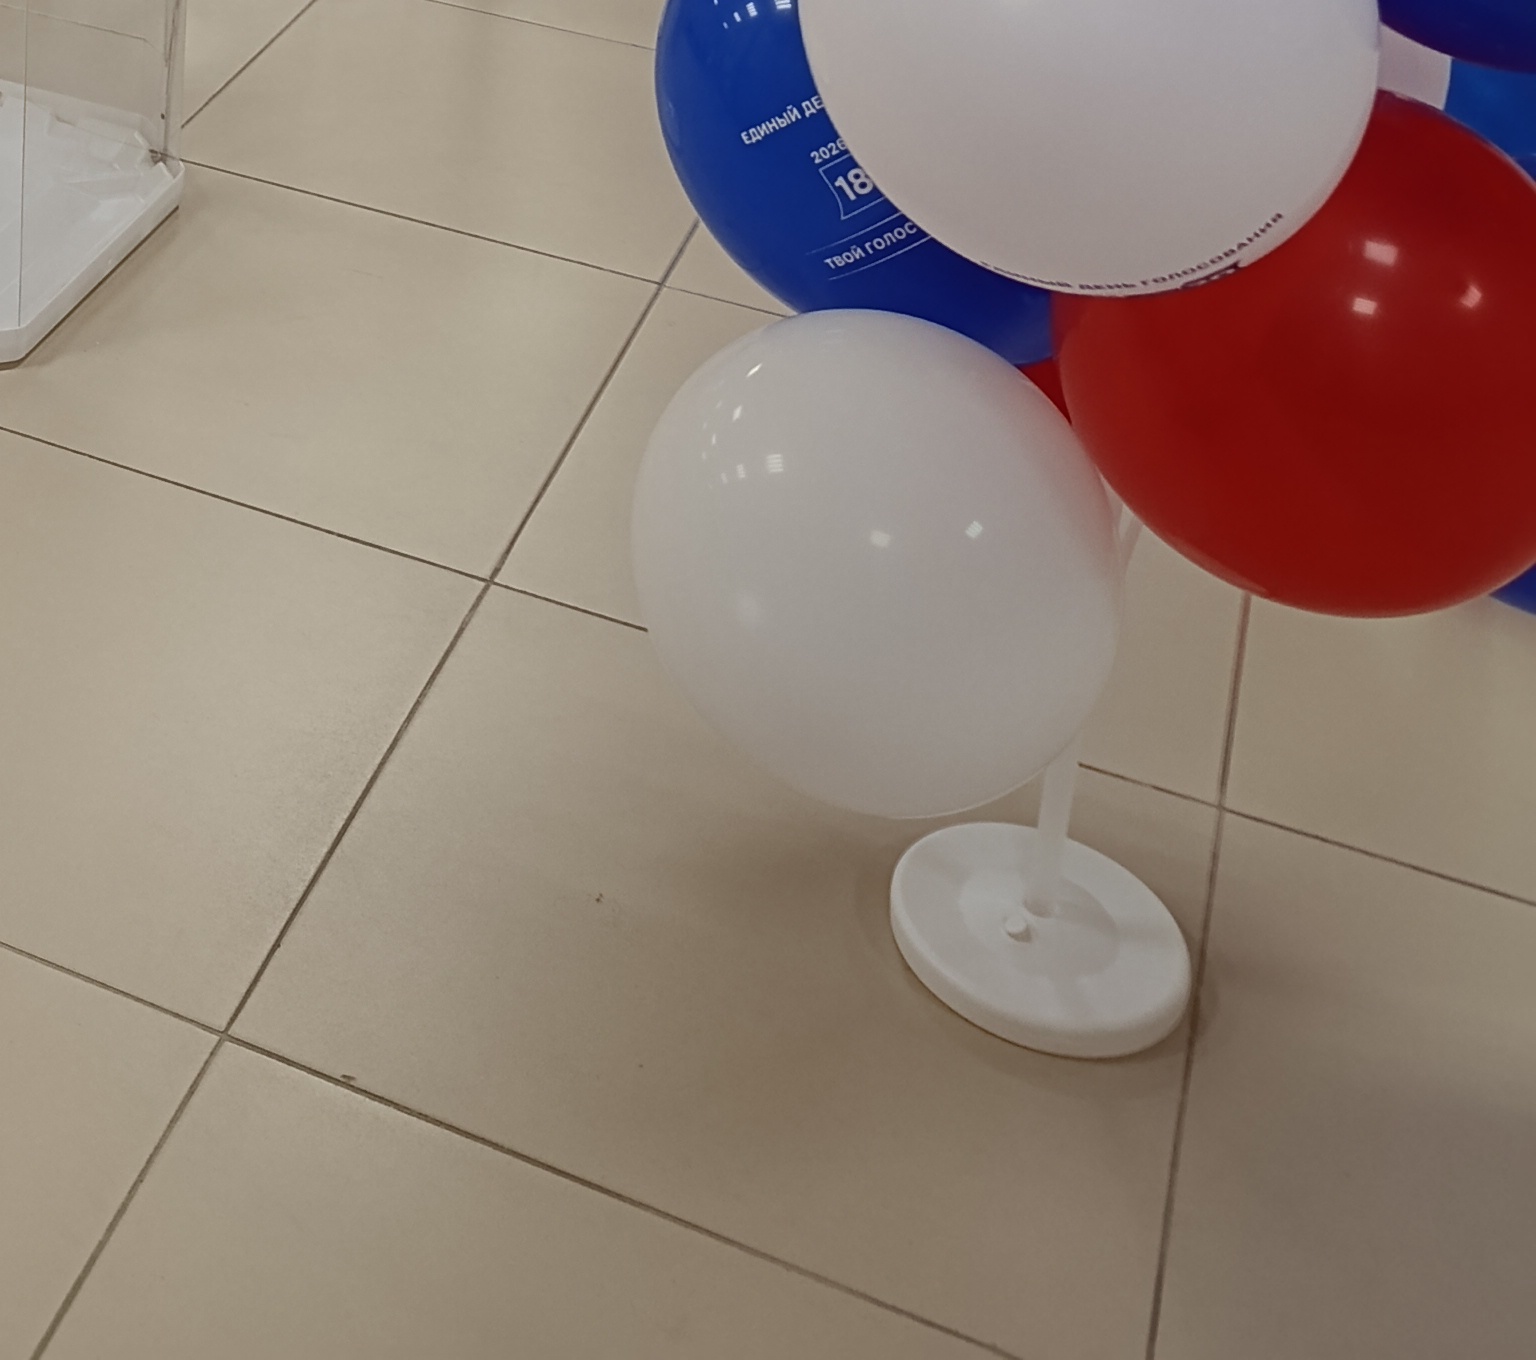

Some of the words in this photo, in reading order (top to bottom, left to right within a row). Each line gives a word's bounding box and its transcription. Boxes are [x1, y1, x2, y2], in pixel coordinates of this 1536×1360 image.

[740, 104, 802, 145] ЕДИНЫЙ
[810, 137, 848, 165] 2026
[834, 167, 874, 202] 18
[824, 244, 865, 270] ТВОЙ
[864, 221, 918, 255] ГОЛОС
